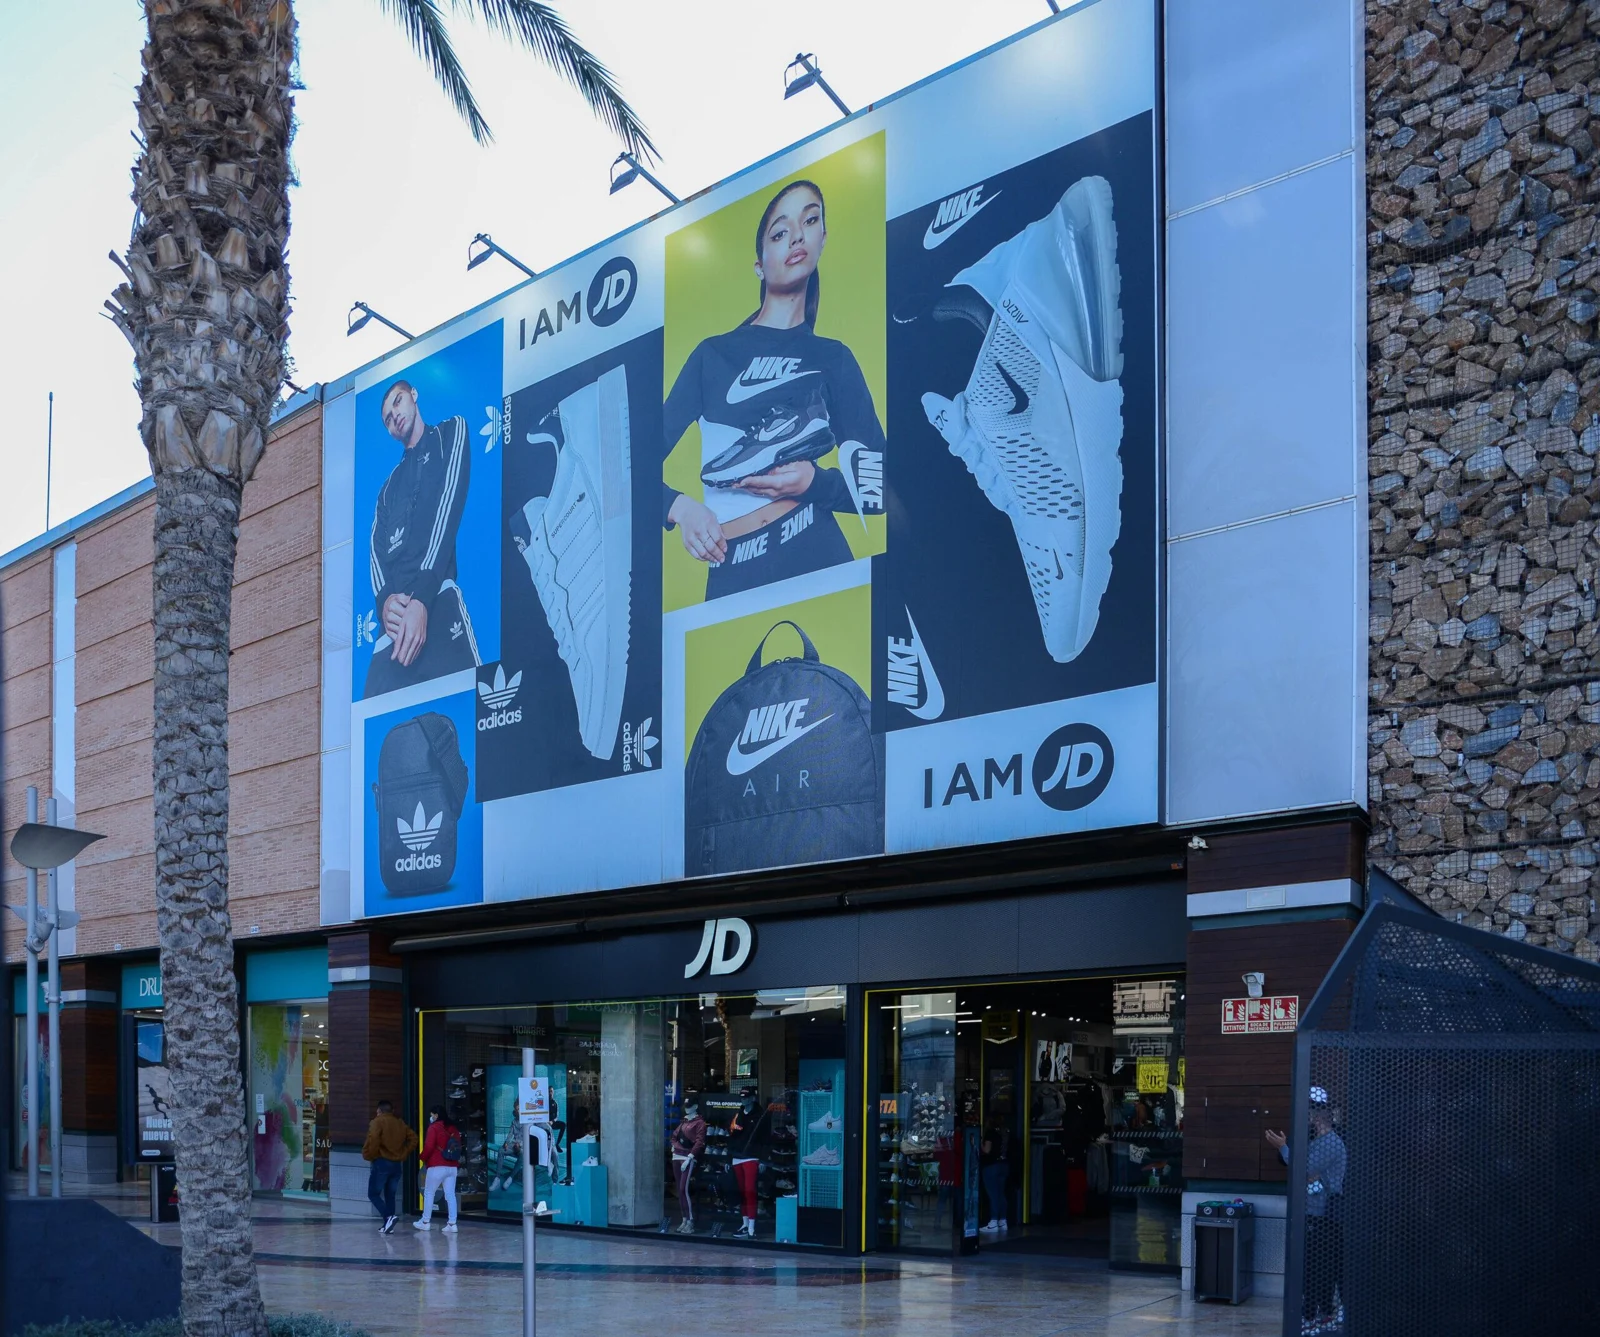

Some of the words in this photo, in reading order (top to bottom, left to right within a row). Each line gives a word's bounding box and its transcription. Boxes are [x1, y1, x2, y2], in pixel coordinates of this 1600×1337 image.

[933, 184, 984, 229] NIKE
[519, 317, 526, 350] I
[531, 290, 582, 346] AM
[592, 269, 632, 318] JD
[742, 356, 802, 381] NIKE
[503, 395, 512, 445] adidas
[857, 450, 884, 510] NIKE
[551, 502, 577, 538] SUPERCOURT
[780, 503, 814, 544] NIKE
[732, 532, 769, 564] NIKE
[887, 635, 919, 707] NIKE
[477, 708, 523, 731] adidas
[740, 698, 810, 746] NIKE
[622, 721, 631, 772] adidas
[742, 769, 811, 798] AIR
[923, 767, 933, 809] I
[941, 753, 1023, 806] AM
[1041, 741, 1104, 794] JD
[395, 850, 442, 872] adidas
[684, 917, 755, 979] JD
